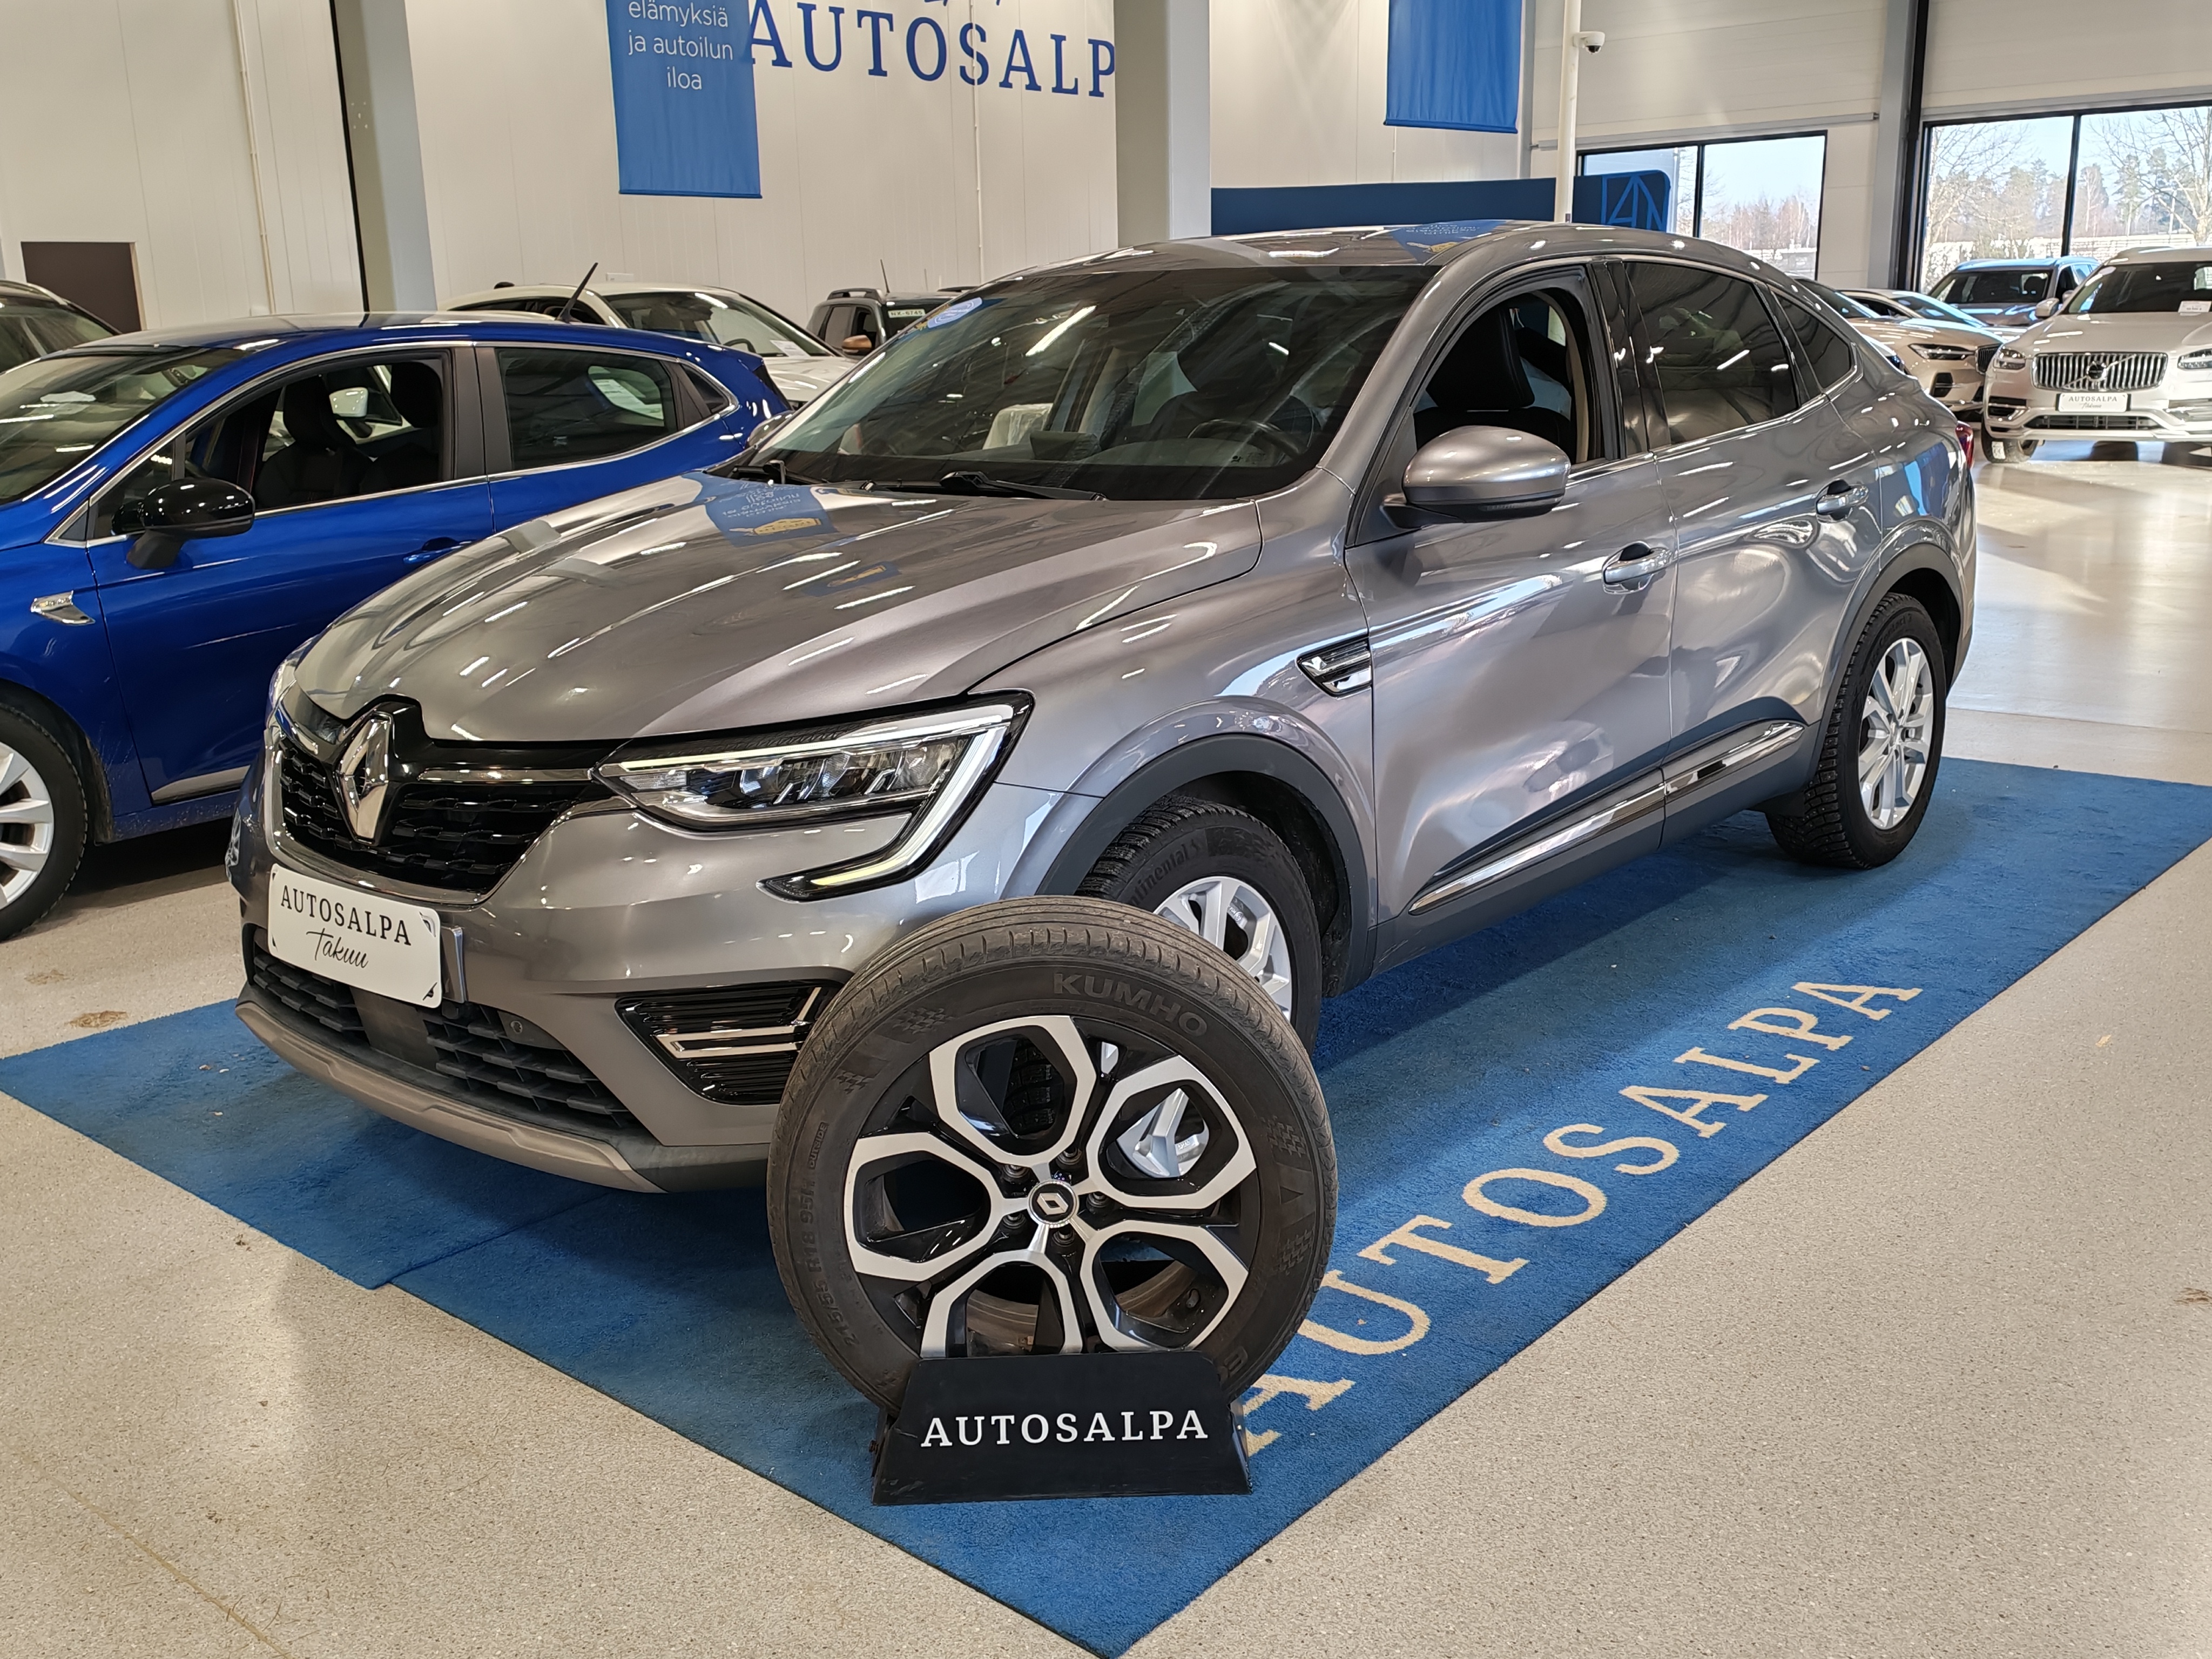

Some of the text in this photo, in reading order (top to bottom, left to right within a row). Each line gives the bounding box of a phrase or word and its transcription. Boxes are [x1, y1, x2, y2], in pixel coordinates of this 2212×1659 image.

[628, 0, 729, 27] elämyksiä
[628, 30, 733, 60] ja autoilun
[666, 66, 703, 90] iloa
[280, 885, 412, 946] AUTOSALPA
[306, 928, 369, 969] Takuu
[1054, 973, 1208, 1037] KUMHO
[808, 1123, 828, 1169] OUTSIDE
[801, 1230, 823, 1273] R18
[812, 1279, 860, 1346] 215/55
[920, 1409, 1209, 1448] AUTOSALPA
